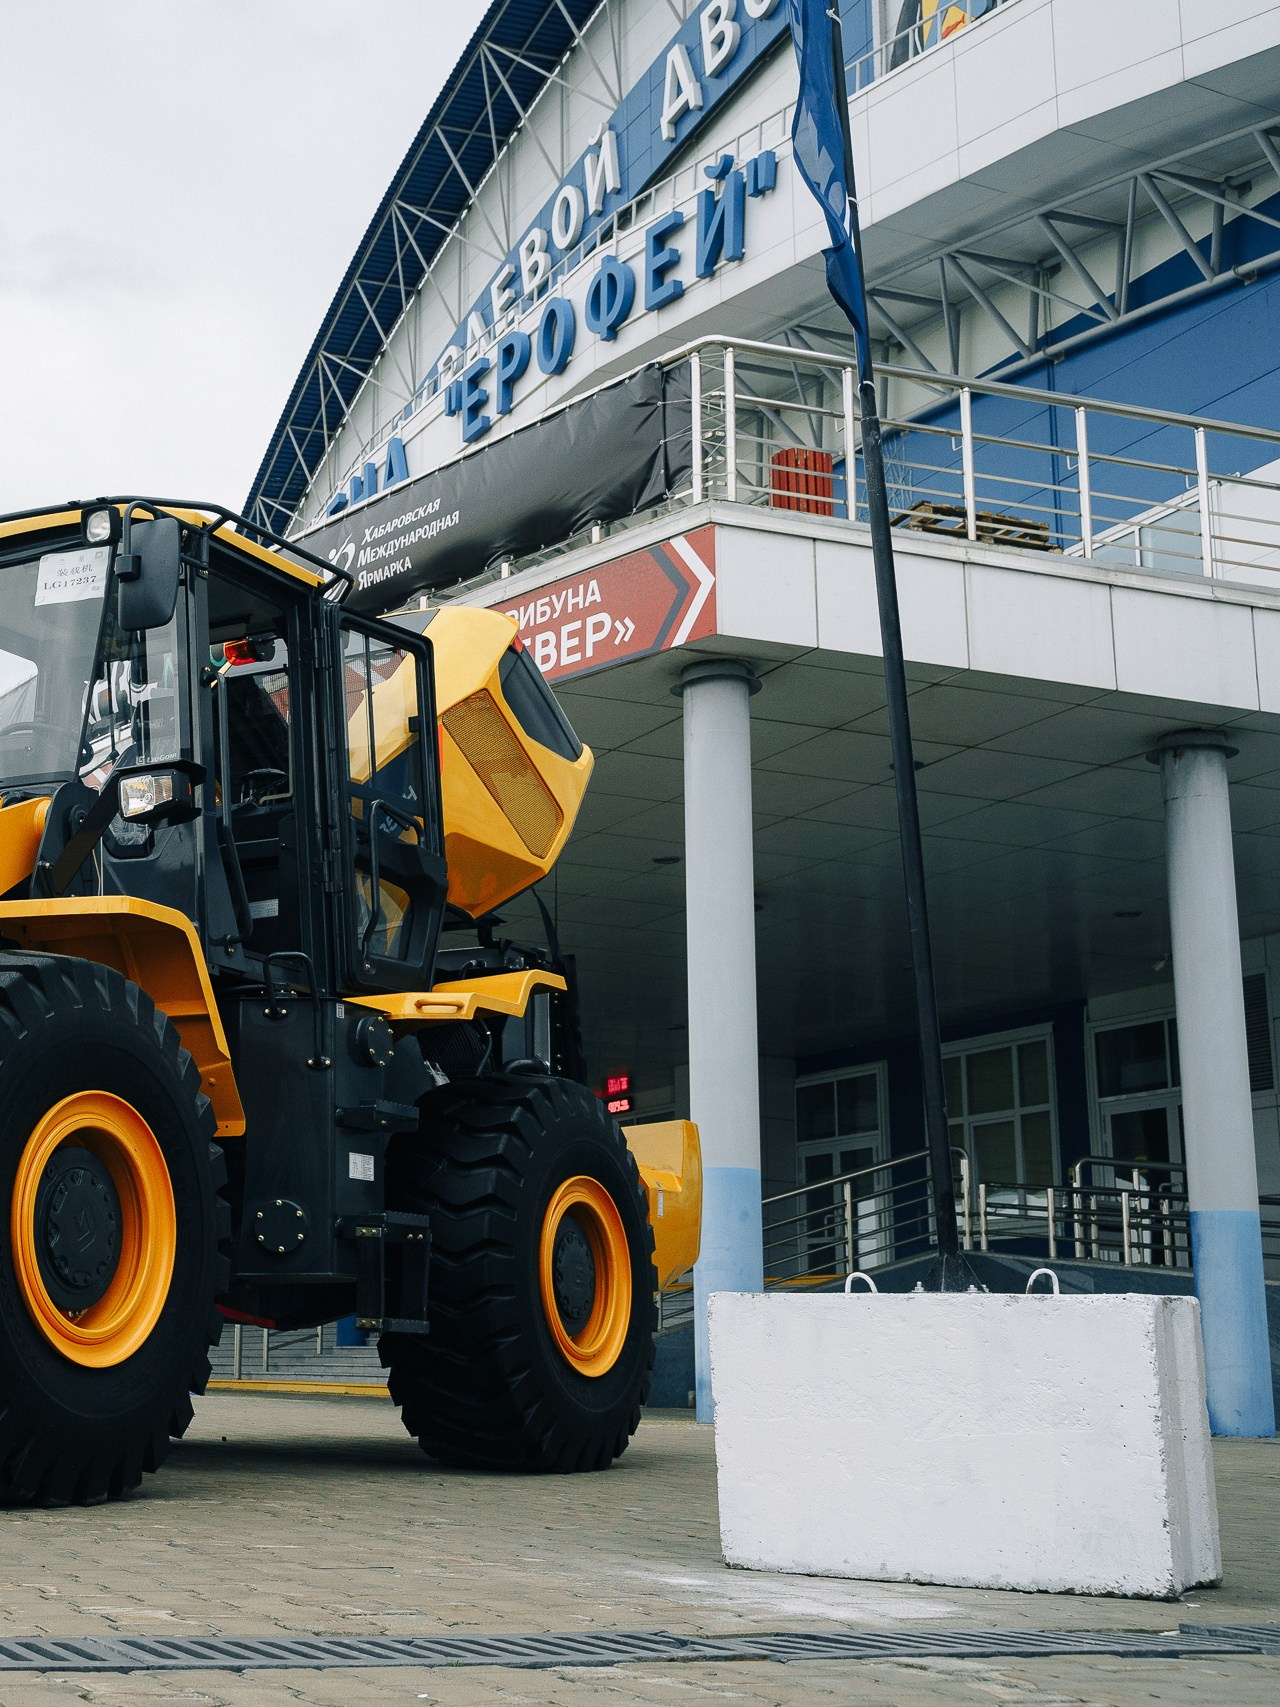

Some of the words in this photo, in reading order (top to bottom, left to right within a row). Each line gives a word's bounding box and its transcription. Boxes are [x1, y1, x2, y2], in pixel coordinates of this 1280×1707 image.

[412, 122, 620, 412] РАЕВОЙ
[660, 0, 783, 142] ДВ
[445, 151, 775, 443] "ЕРОФЕЙ"
[357, 510, 459, 568] МЕЖДУНАРОДНАЯ
[361, 498, 441, 545] ХАБАРОВСКАЯ
[44, 575, 97, 590] LG17237
[358, 556, 412, 591] ЯРМАРКА
[522, 612, 636, 673] ВЕР»
